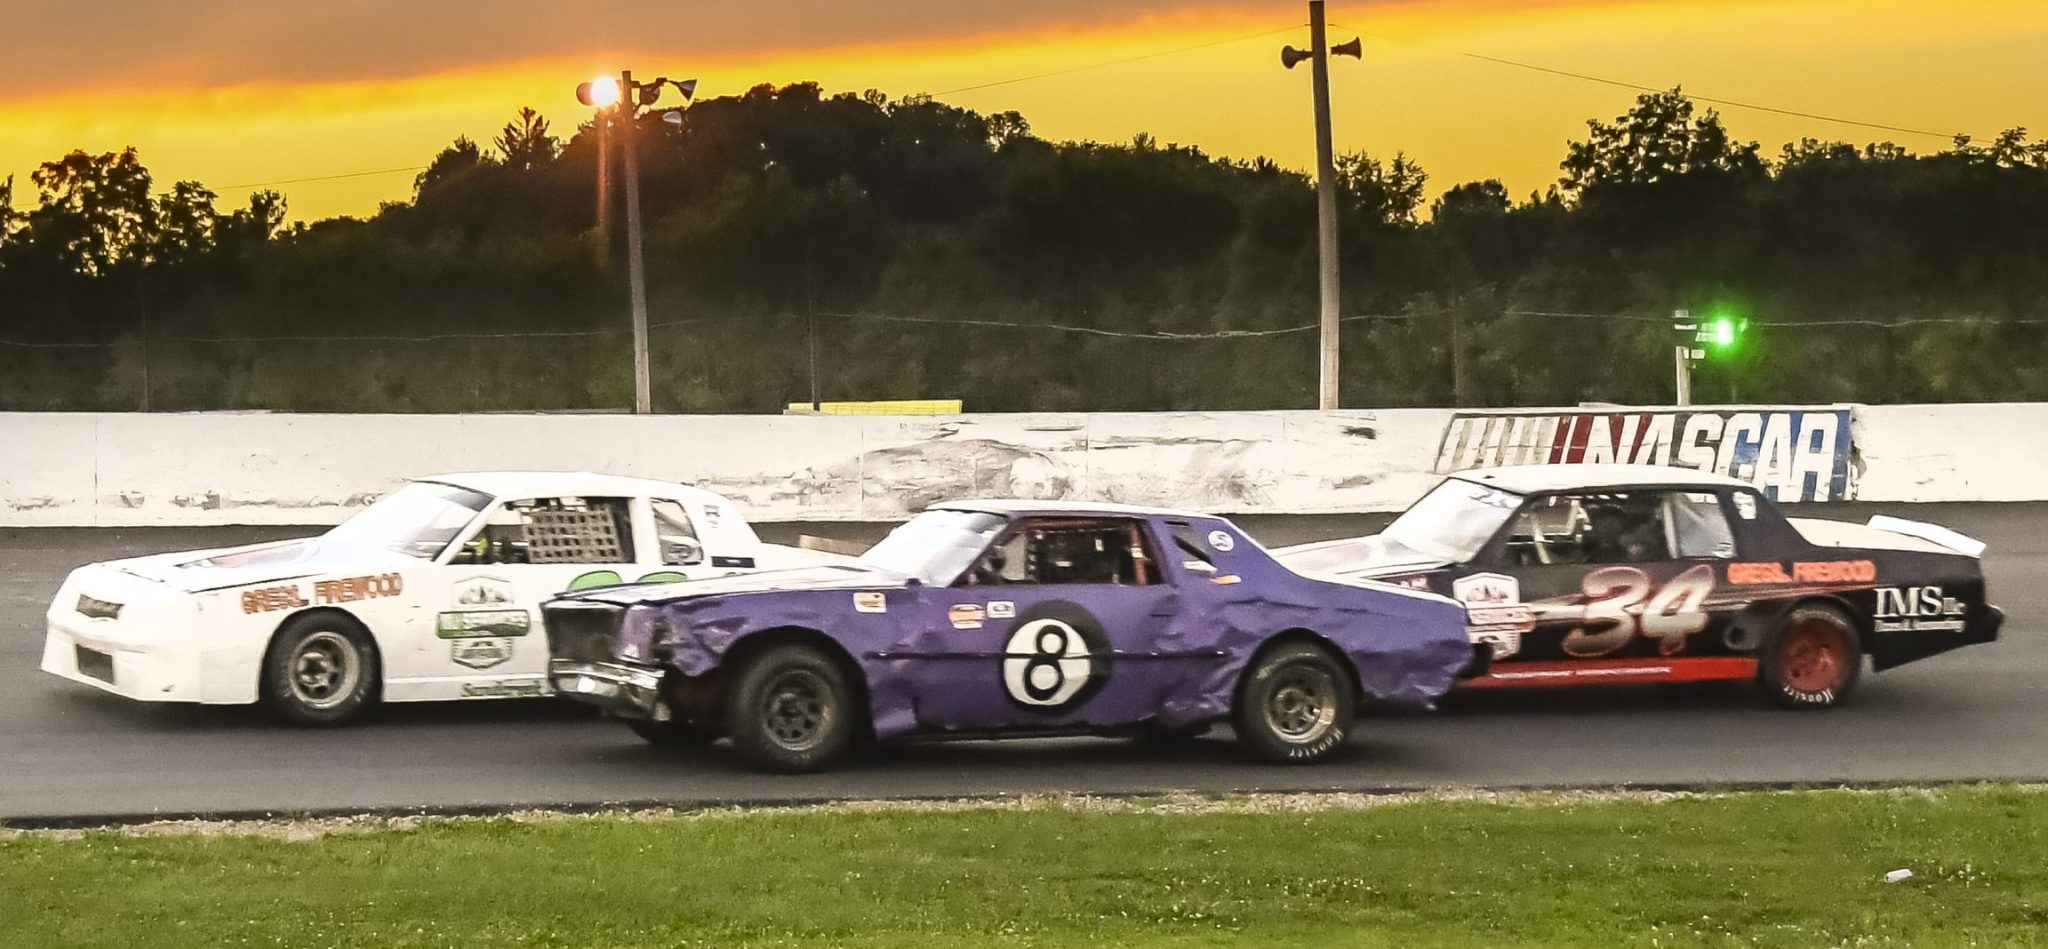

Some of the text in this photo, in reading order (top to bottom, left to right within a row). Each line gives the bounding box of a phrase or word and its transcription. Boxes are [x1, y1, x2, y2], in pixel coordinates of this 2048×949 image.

[1580, 411, 1840, 503] NASCAR
[1561, 564, 1716, 657] 34
[1872, 586, 1942, 617] IMS
[1023, 624, 1068, 701] 8
